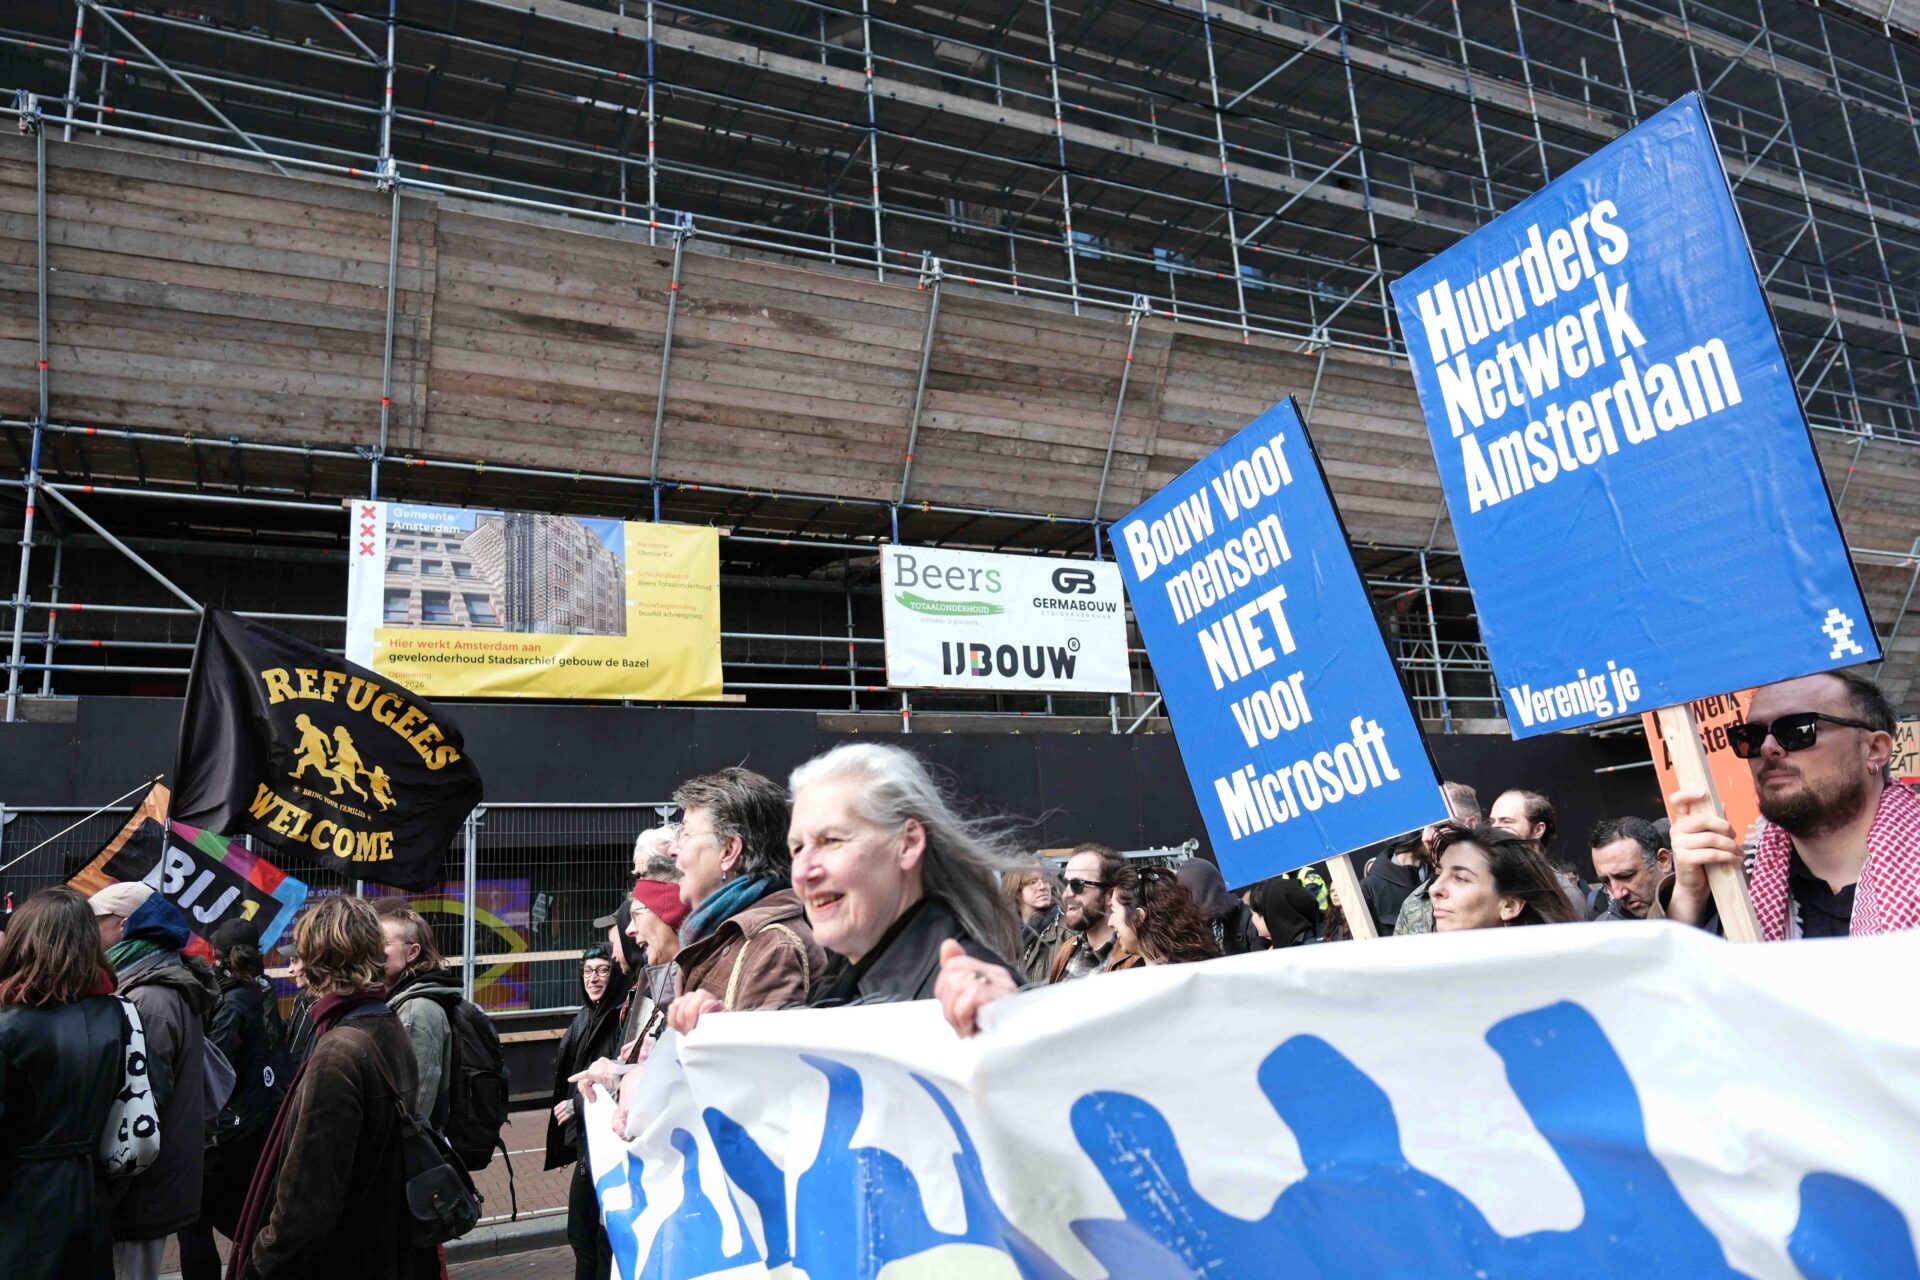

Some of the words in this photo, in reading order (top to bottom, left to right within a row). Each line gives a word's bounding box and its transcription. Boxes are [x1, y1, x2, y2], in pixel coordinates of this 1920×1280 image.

[1416, 199, 1629, 364] Huurders
[1436, 272, 1647, 438] Netwerk
[1460, 337, 1743, 514] Amsterdam
[393, 508, 455, 522] Gemeente
[393, 520, 460, 533] Amsterdam
[1123, 488, 1215, 582] Bouw
[1212, 433, 1293, 521] voor
[659, 581, 712, 591] Totaalonderhoud
[893, 553, 1002, 593] Beers
[1165, 513, 1292, 625] mensen
[911, 602, 989, 614] TOTAALONDERHOUD
[1033, 597, 1117, 613] GERMABOUW
[1198, 584, 1296, 691] NIET
[388, 653, 485, 664] gevelonderhoud
[488, 655, 556, 665] Stadsarchief
[558, 657, 602, 667] gebouw
[605, 658, 619, 667] de
[622, 659, 649, 668] Bazel
[389, 639, 413, 648] Hier
[417, 640, 450, 649] werkt
[454, 640, 519, 651] Amsterdam
[521, 643, 541, 652] aan
[261, 667, 460, 770] REFUGEES
[1231, 670, 1312, 749] voor
[1510, 668, 1614, 727] Verenig
[1607, 660, 1640, 713] je
[303, 788, 323, 800] BRING
[323, 796, 338, 809] YOUR
[1214, 715, 1400, 841] Microsoft
[248, 782, 394, 862] WELCOME
[317, 887, 341, 897] stad
